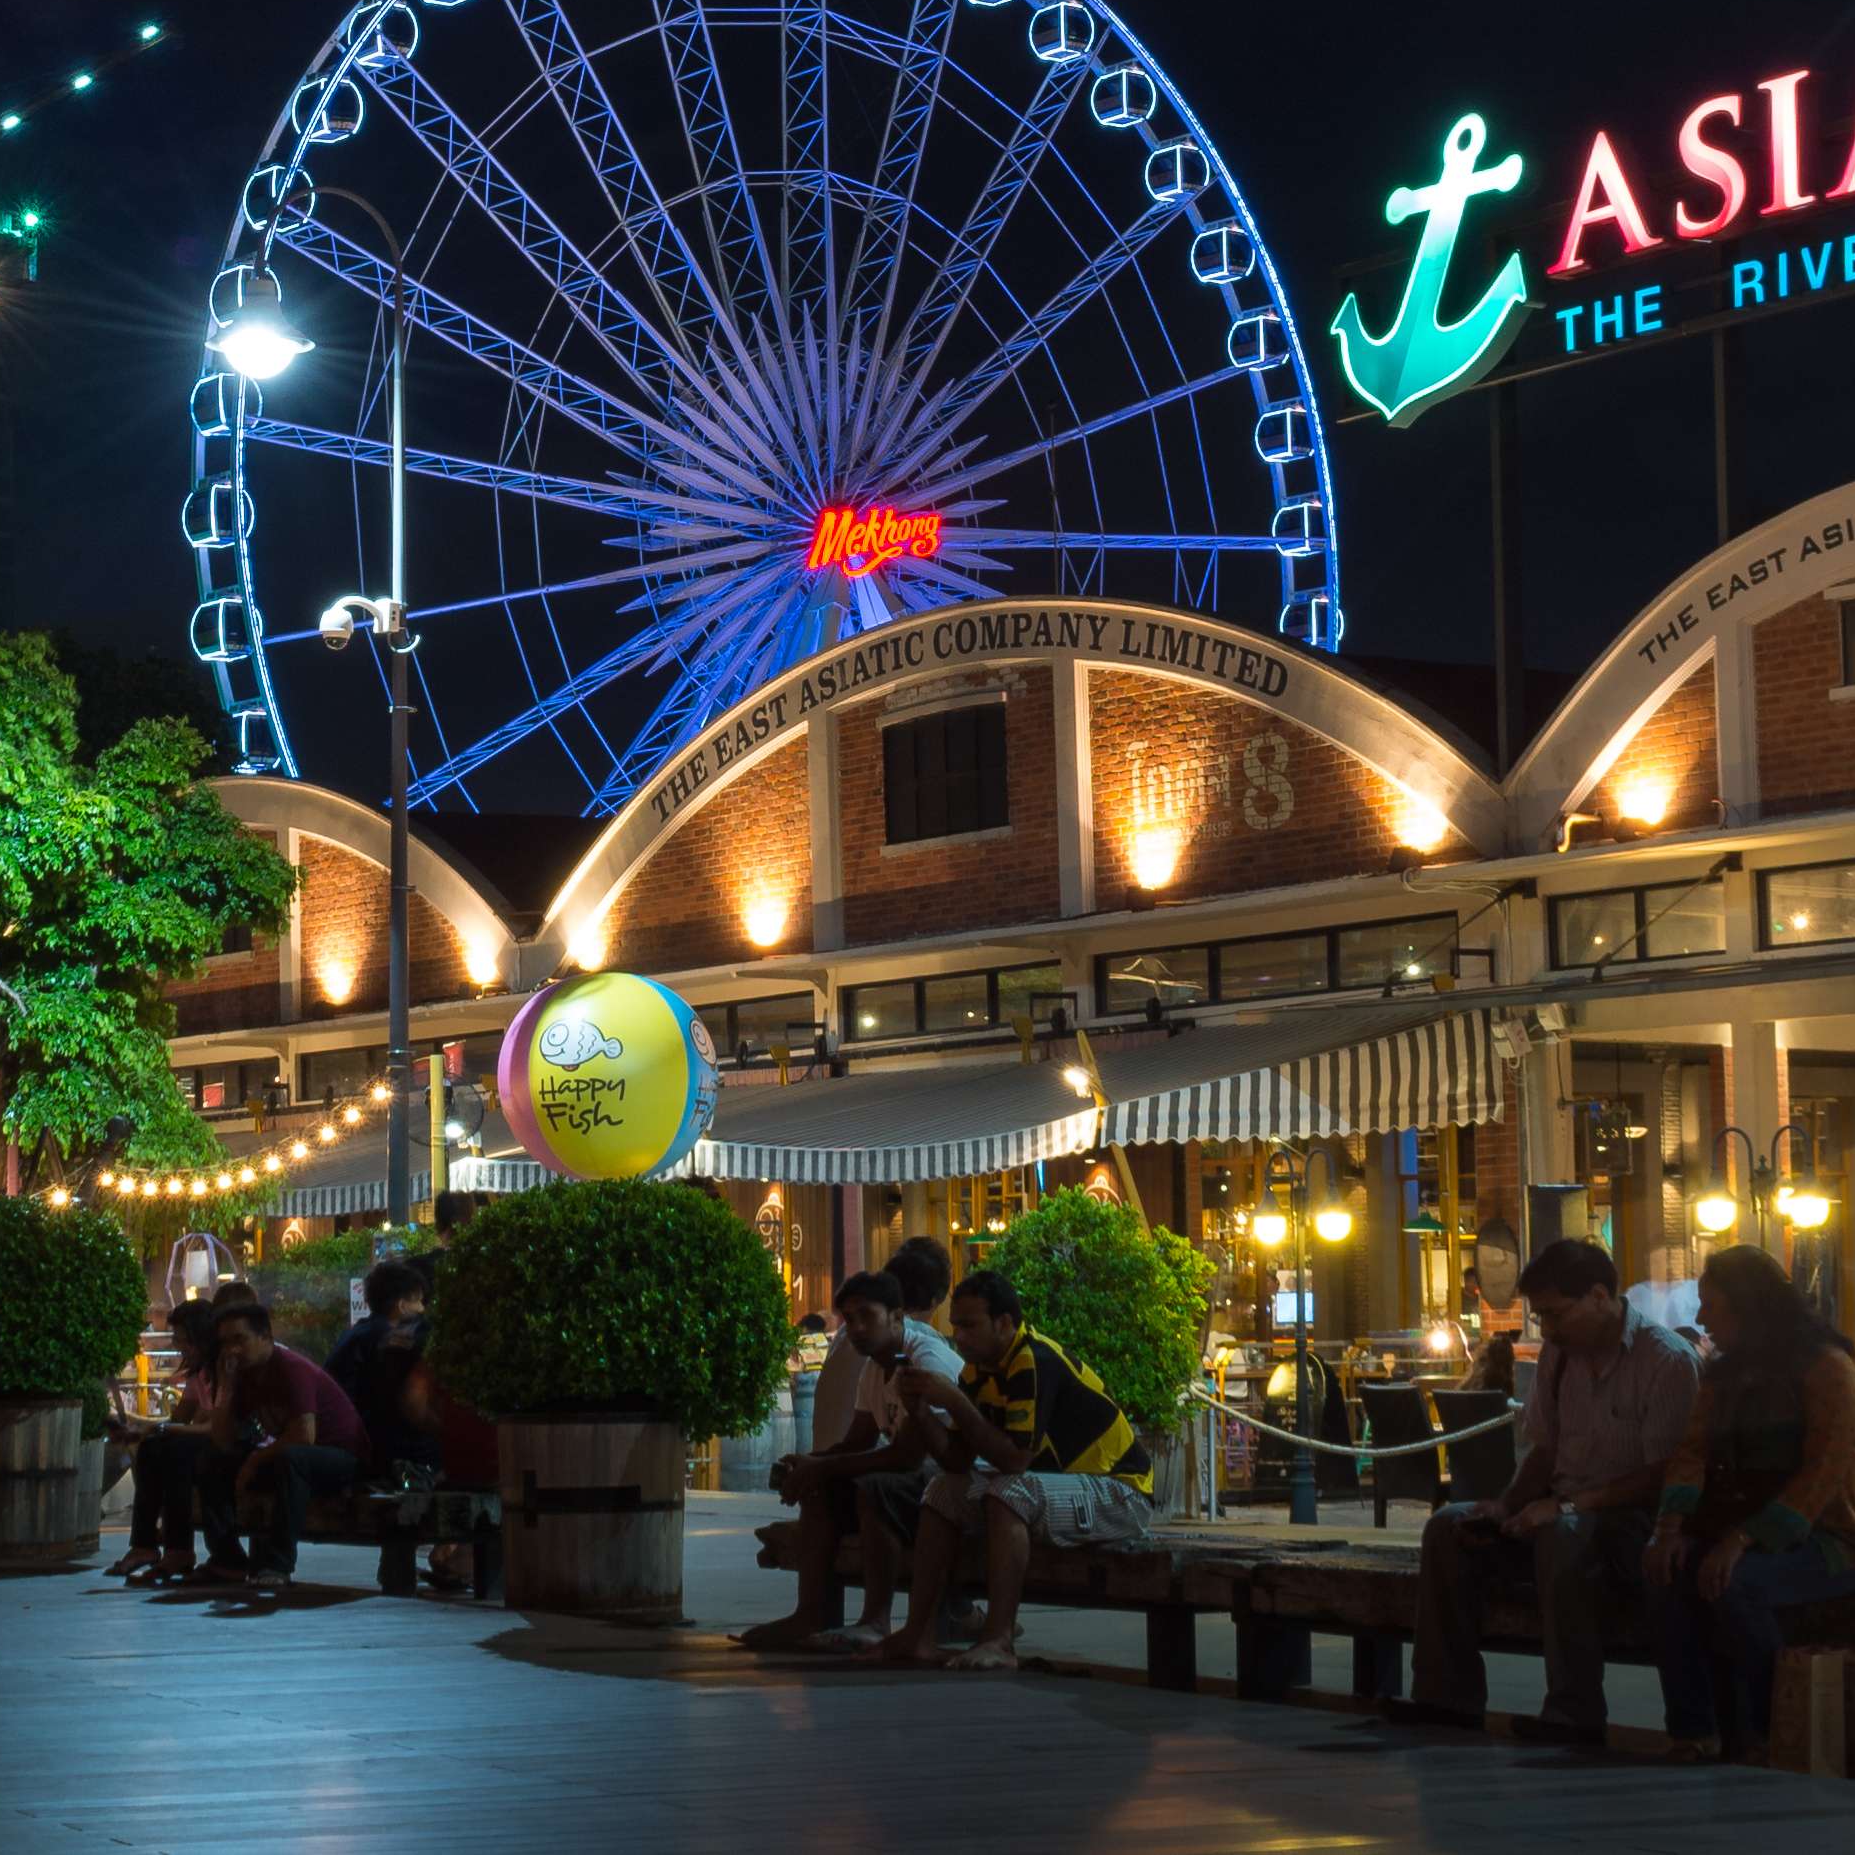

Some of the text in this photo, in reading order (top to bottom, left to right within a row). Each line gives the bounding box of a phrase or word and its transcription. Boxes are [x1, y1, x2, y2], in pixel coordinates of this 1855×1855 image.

[1556, 284, 1663, 352] THE
[808, 507, 940, 577] Mekhong
[1638, 604, 1700, 665] THE
[1705, 548, 1787, 611] EAST
[651, 611, 1289, 823] THE EAST ASIATIC COMPANY LIMITED
[1243, 729, 1294, 830] 8
[539, 1076, 626, 1101] Happy
[540, 1101, 623, 1135] Fish
